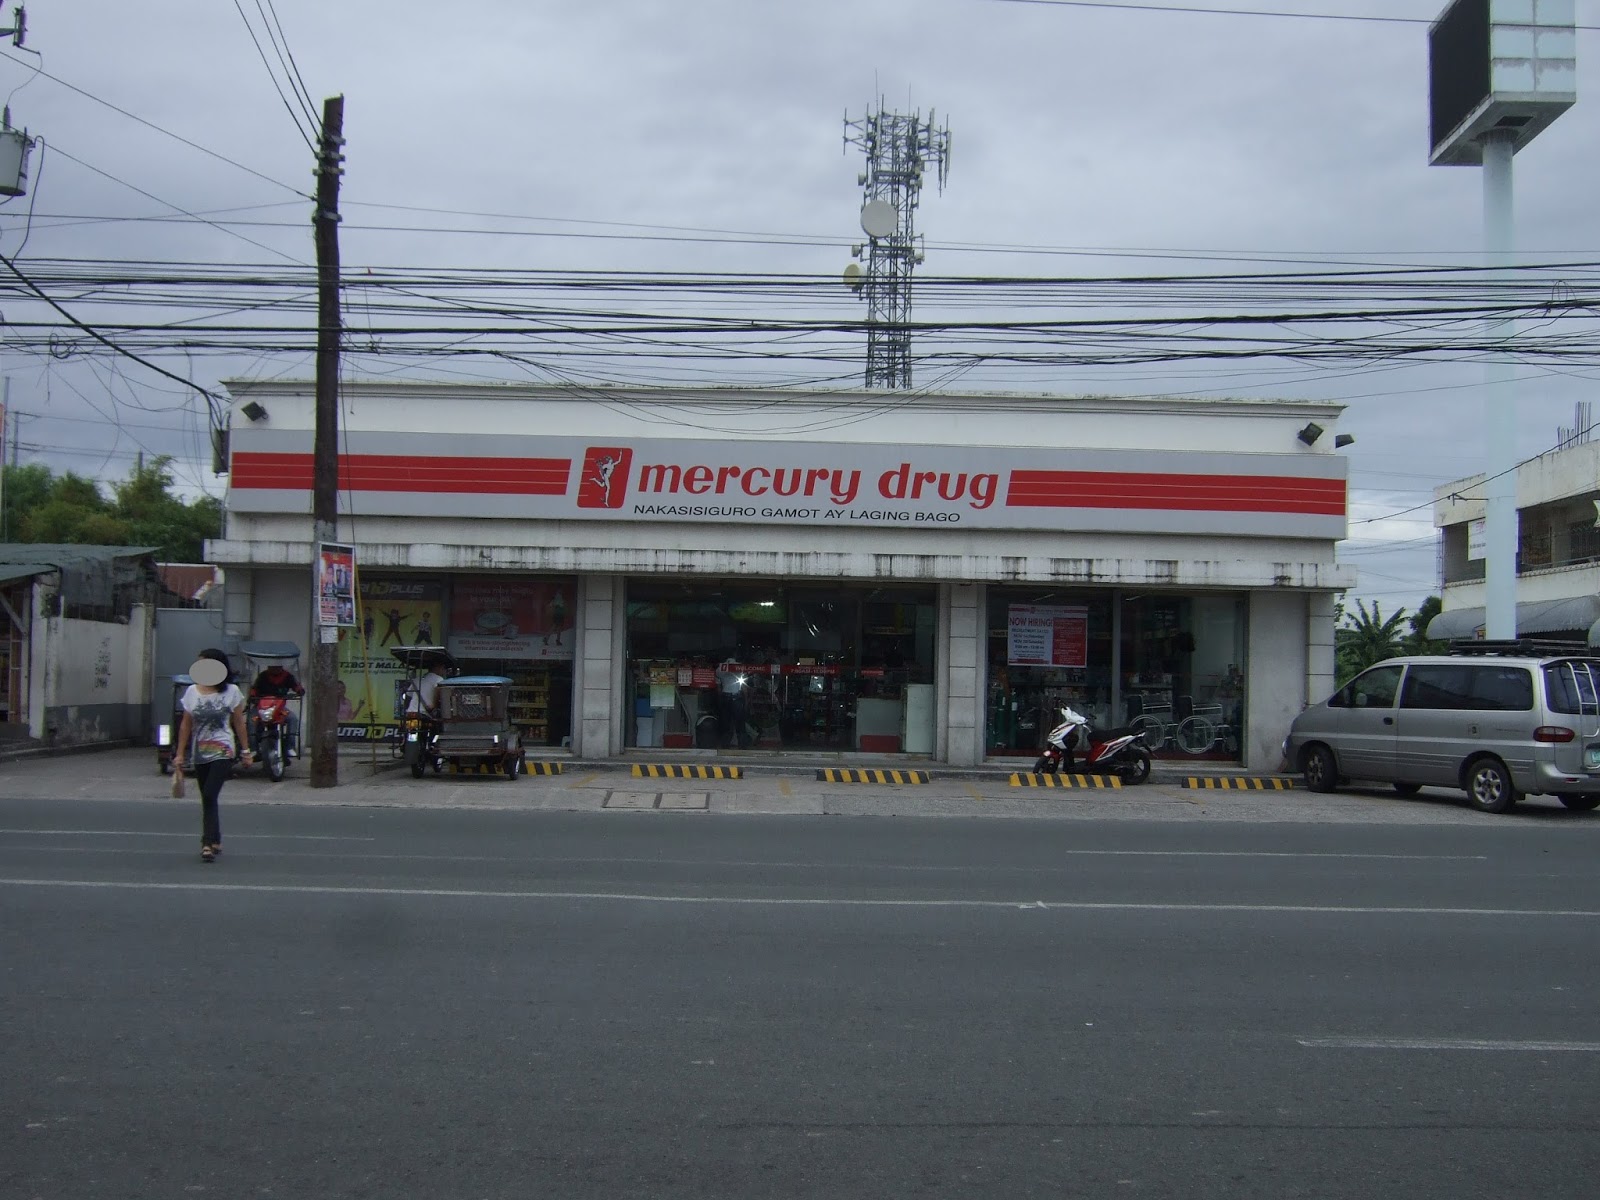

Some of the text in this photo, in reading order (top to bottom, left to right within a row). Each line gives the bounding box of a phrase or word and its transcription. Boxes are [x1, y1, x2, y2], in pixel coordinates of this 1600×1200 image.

[638, 463, 999, 510] mercury drug
[634, 504, 961, 523] NAKASISIGURO GAMOT AY LAGING BAGO
[1009, 617, 1053, 628] NOW HIRING!
